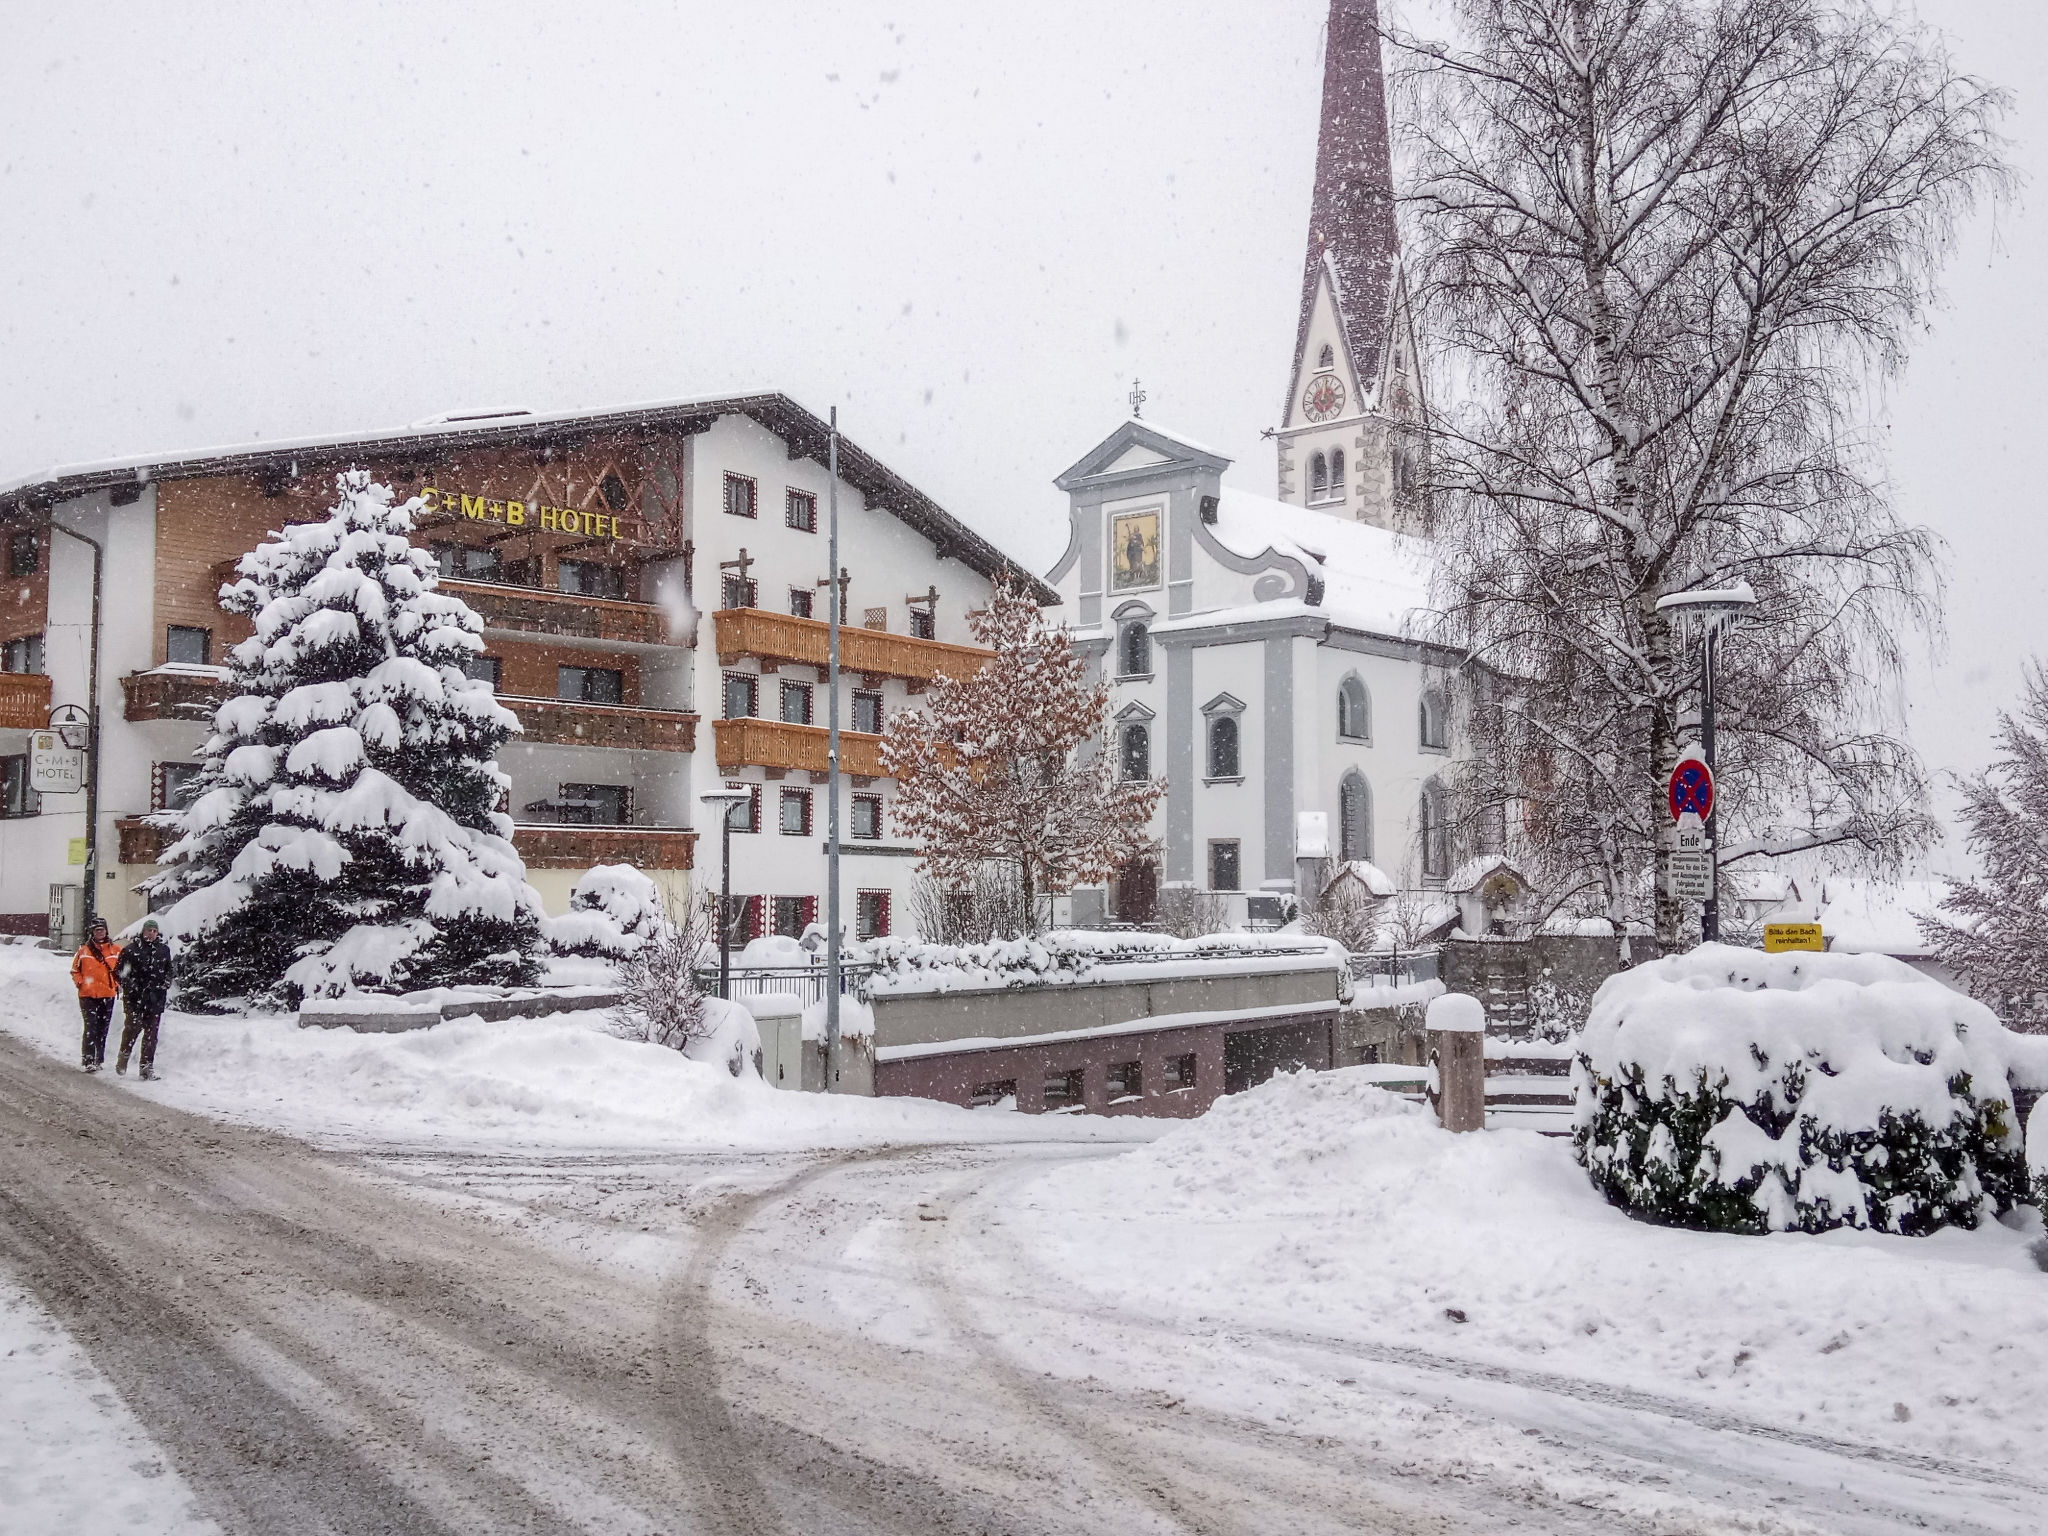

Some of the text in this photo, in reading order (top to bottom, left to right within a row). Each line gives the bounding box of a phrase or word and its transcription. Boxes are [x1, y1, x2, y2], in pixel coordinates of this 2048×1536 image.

[419, 487, 624, 539] C+M+B HOTEL
[36, 768, 76, 780] HOTEL
[1680, 834, 1700, 847] Ende
